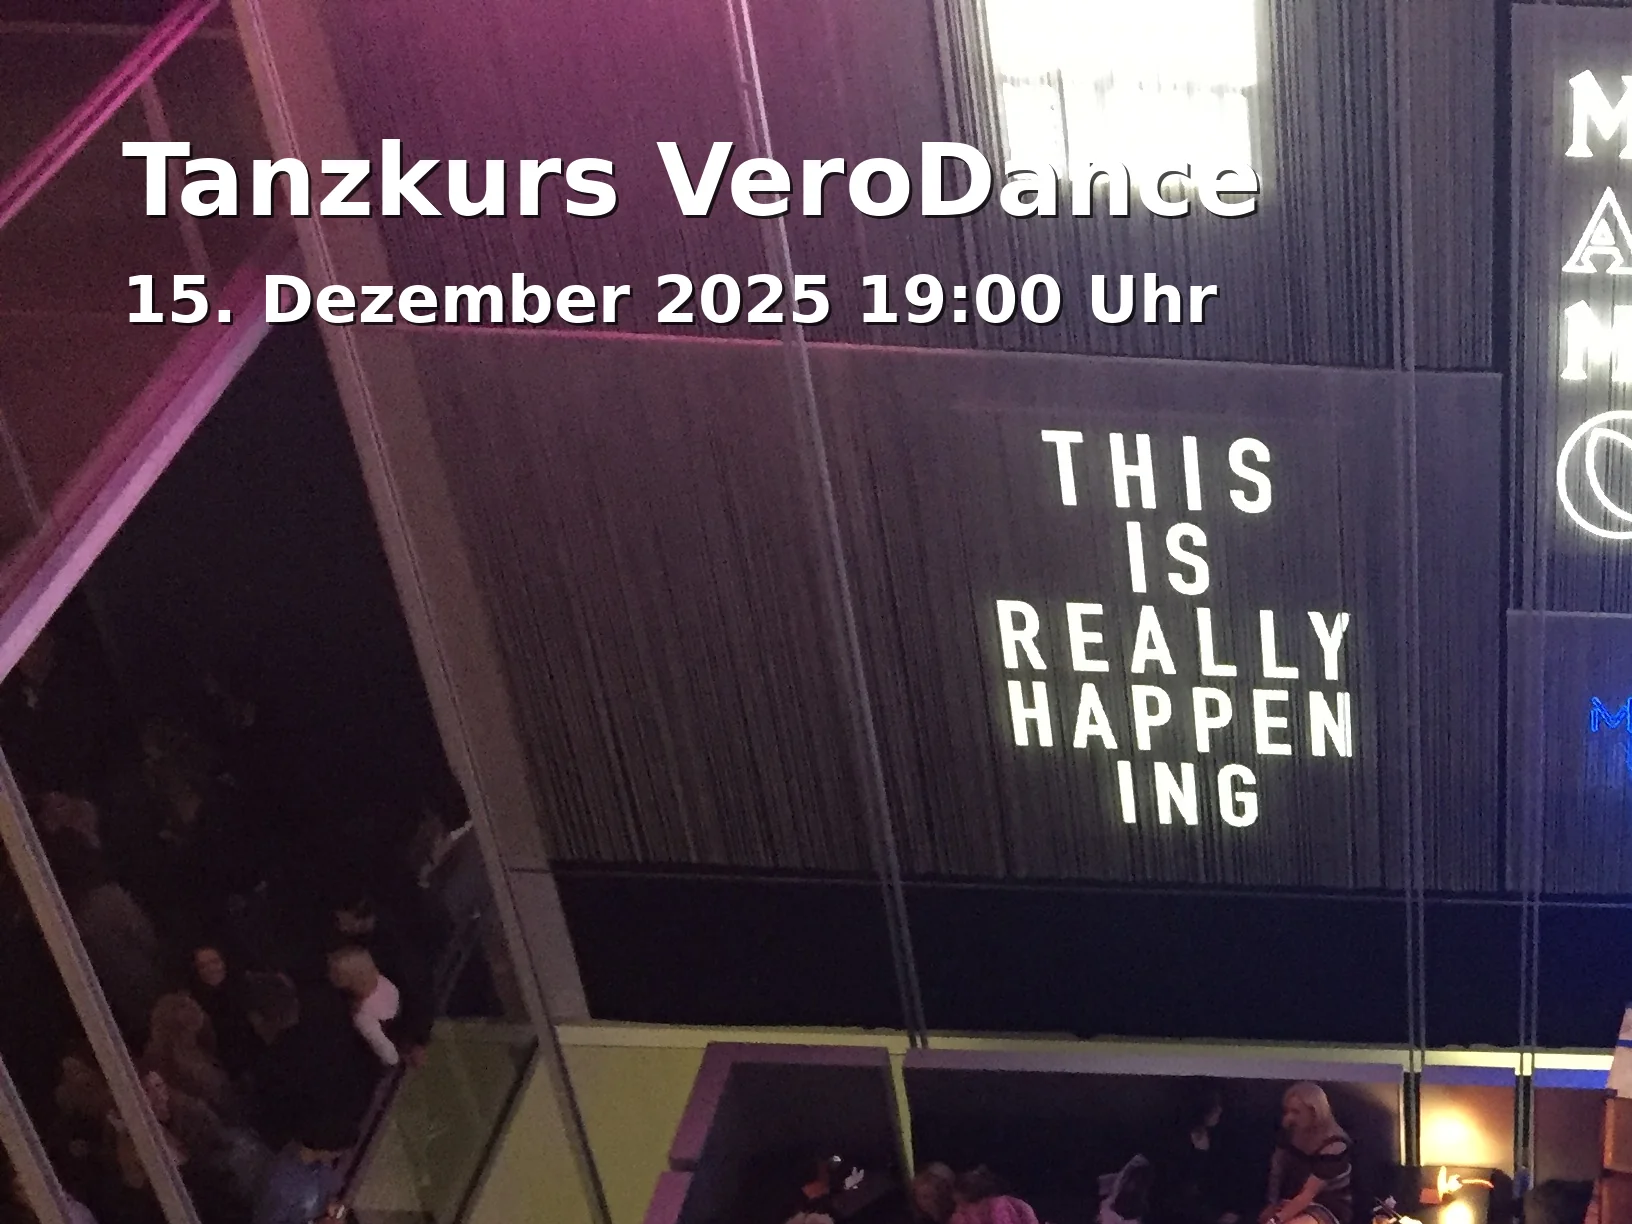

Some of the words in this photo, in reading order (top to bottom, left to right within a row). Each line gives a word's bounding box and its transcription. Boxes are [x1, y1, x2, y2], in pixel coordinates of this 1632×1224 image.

[1041, 429, 1272, 514] THIS
[1126, 521, 1210, 596] IS
[996, 600, 1352, 681] REALLY
[1006, 680, 1353, 758] HAPPEN
[1116, 760, 1259, 828] ING
